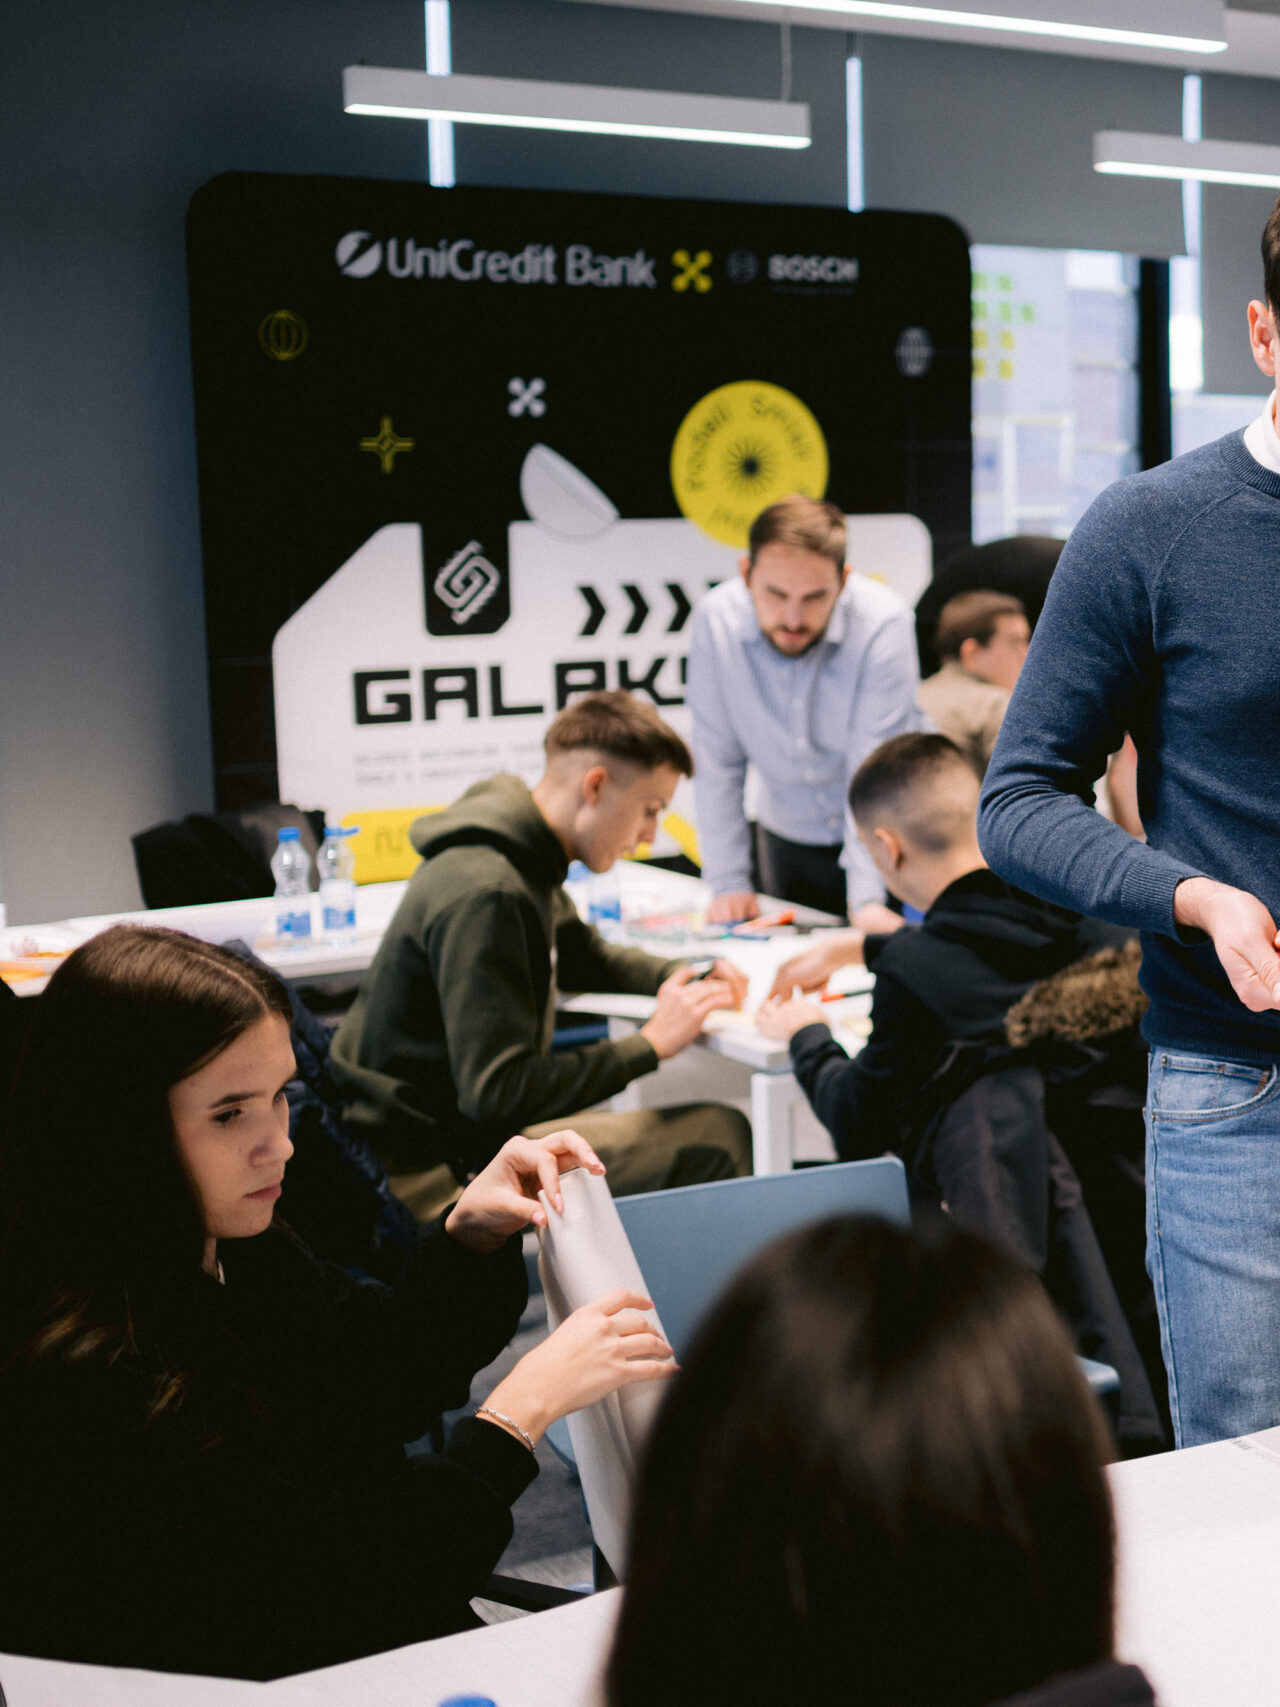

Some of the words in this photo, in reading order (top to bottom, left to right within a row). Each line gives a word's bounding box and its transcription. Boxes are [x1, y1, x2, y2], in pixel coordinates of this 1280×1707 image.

[386, 236, 557, 285] UniCredit
[565, 243, 657, 288] Bank
[768, 253, 859, 283] BOSCH
[353, 656, 688, 725] GALAK
